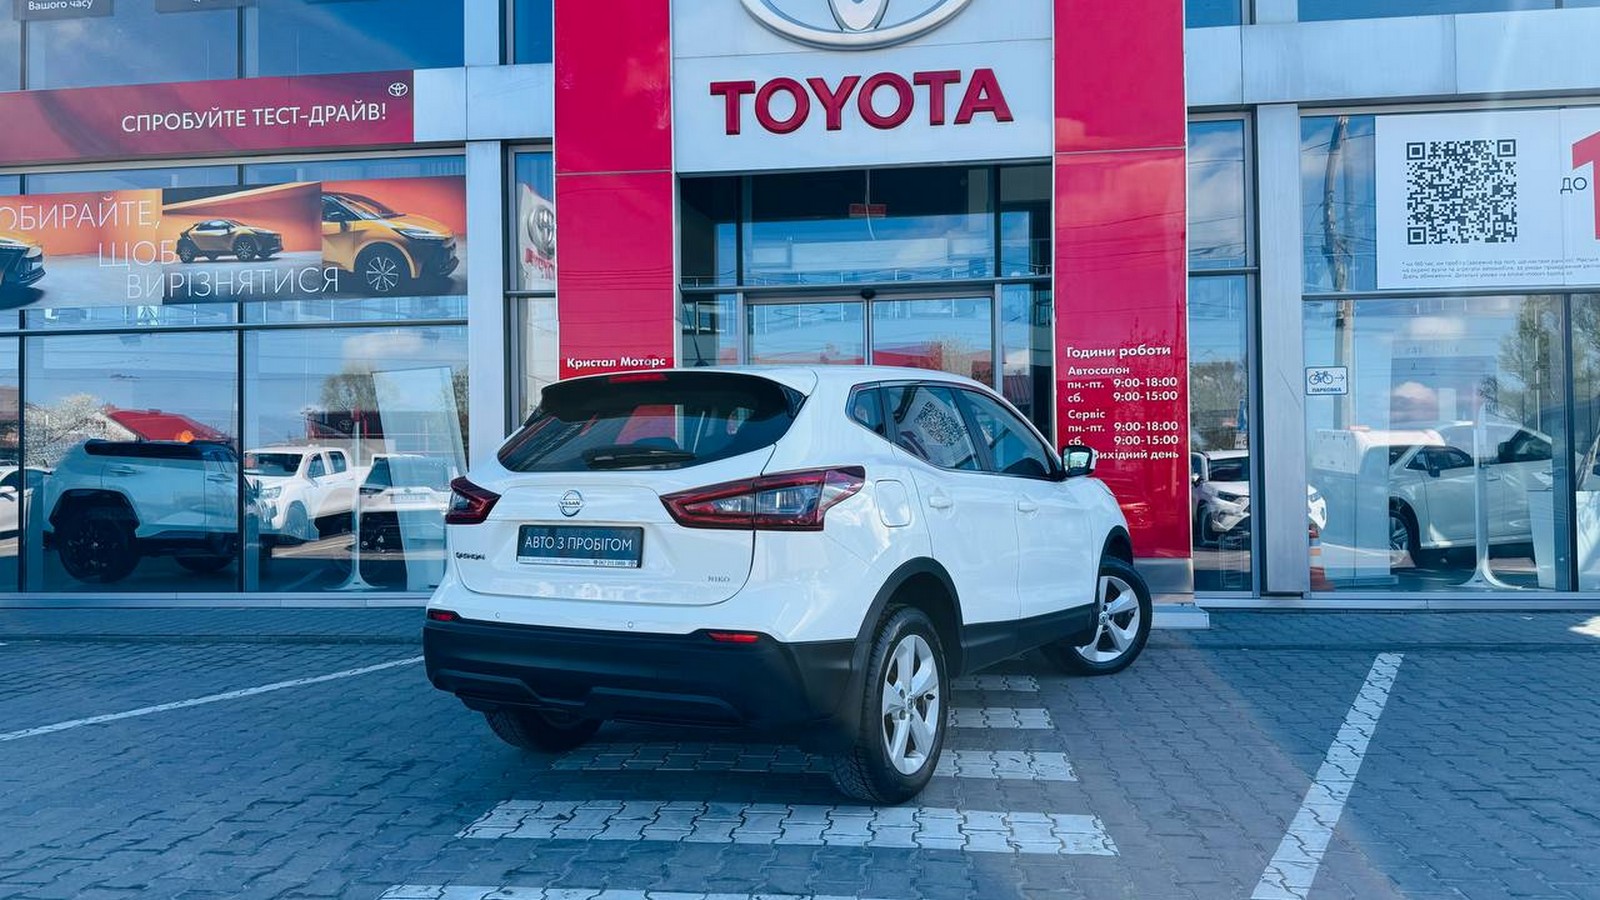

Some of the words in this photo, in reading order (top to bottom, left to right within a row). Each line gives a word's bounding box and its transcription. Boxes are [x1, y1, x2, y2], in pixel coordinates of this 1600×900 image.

[28, 0, 67, 10] Вашого
[70, 0, 93, 9] часу
[709, 68, 1014, 135] TOYOTA
[121, 107, 246, 132] СПРОБУЙТЕ
[252, 100, 387, 128] ТЕСТ-ДРАЙВ!
[98, 239, 176, 270] ЩОБ
[127, 266, 339, 299] ВИРІЗНЯТИСЯ
[1066, 346, 1115, 358] Години
[1119, 344, 1171, 358] роботи
[567, 358, 616, 369] Кристал
[620, 357, 666, 368] Моторс
[1068, 366, 1130, 375] Автосалон
[1067, 381, 1105, 389] пн.-пт.
[1113, 377, 1178, 388] 9:00-18:00
[1067, 392, 1084, 403] сб.
[1113, 391, 1178, 401] 9:00-15:00
[1068, 409, 1106, 421] Сервіс
[1068, 424, 1105, 432] пн.-пт.
[1114, 421, 1178, 432] 9:00-18:00
[1068, 436, 1085, 446] сб.
[1114, 435, 1179, 445] 9:00-15:00
[1150, 451, 1179, 460] день
[525, 536, 554, 549] АВТО
[567, 537, 632, 551] ПРОБІГОМ
